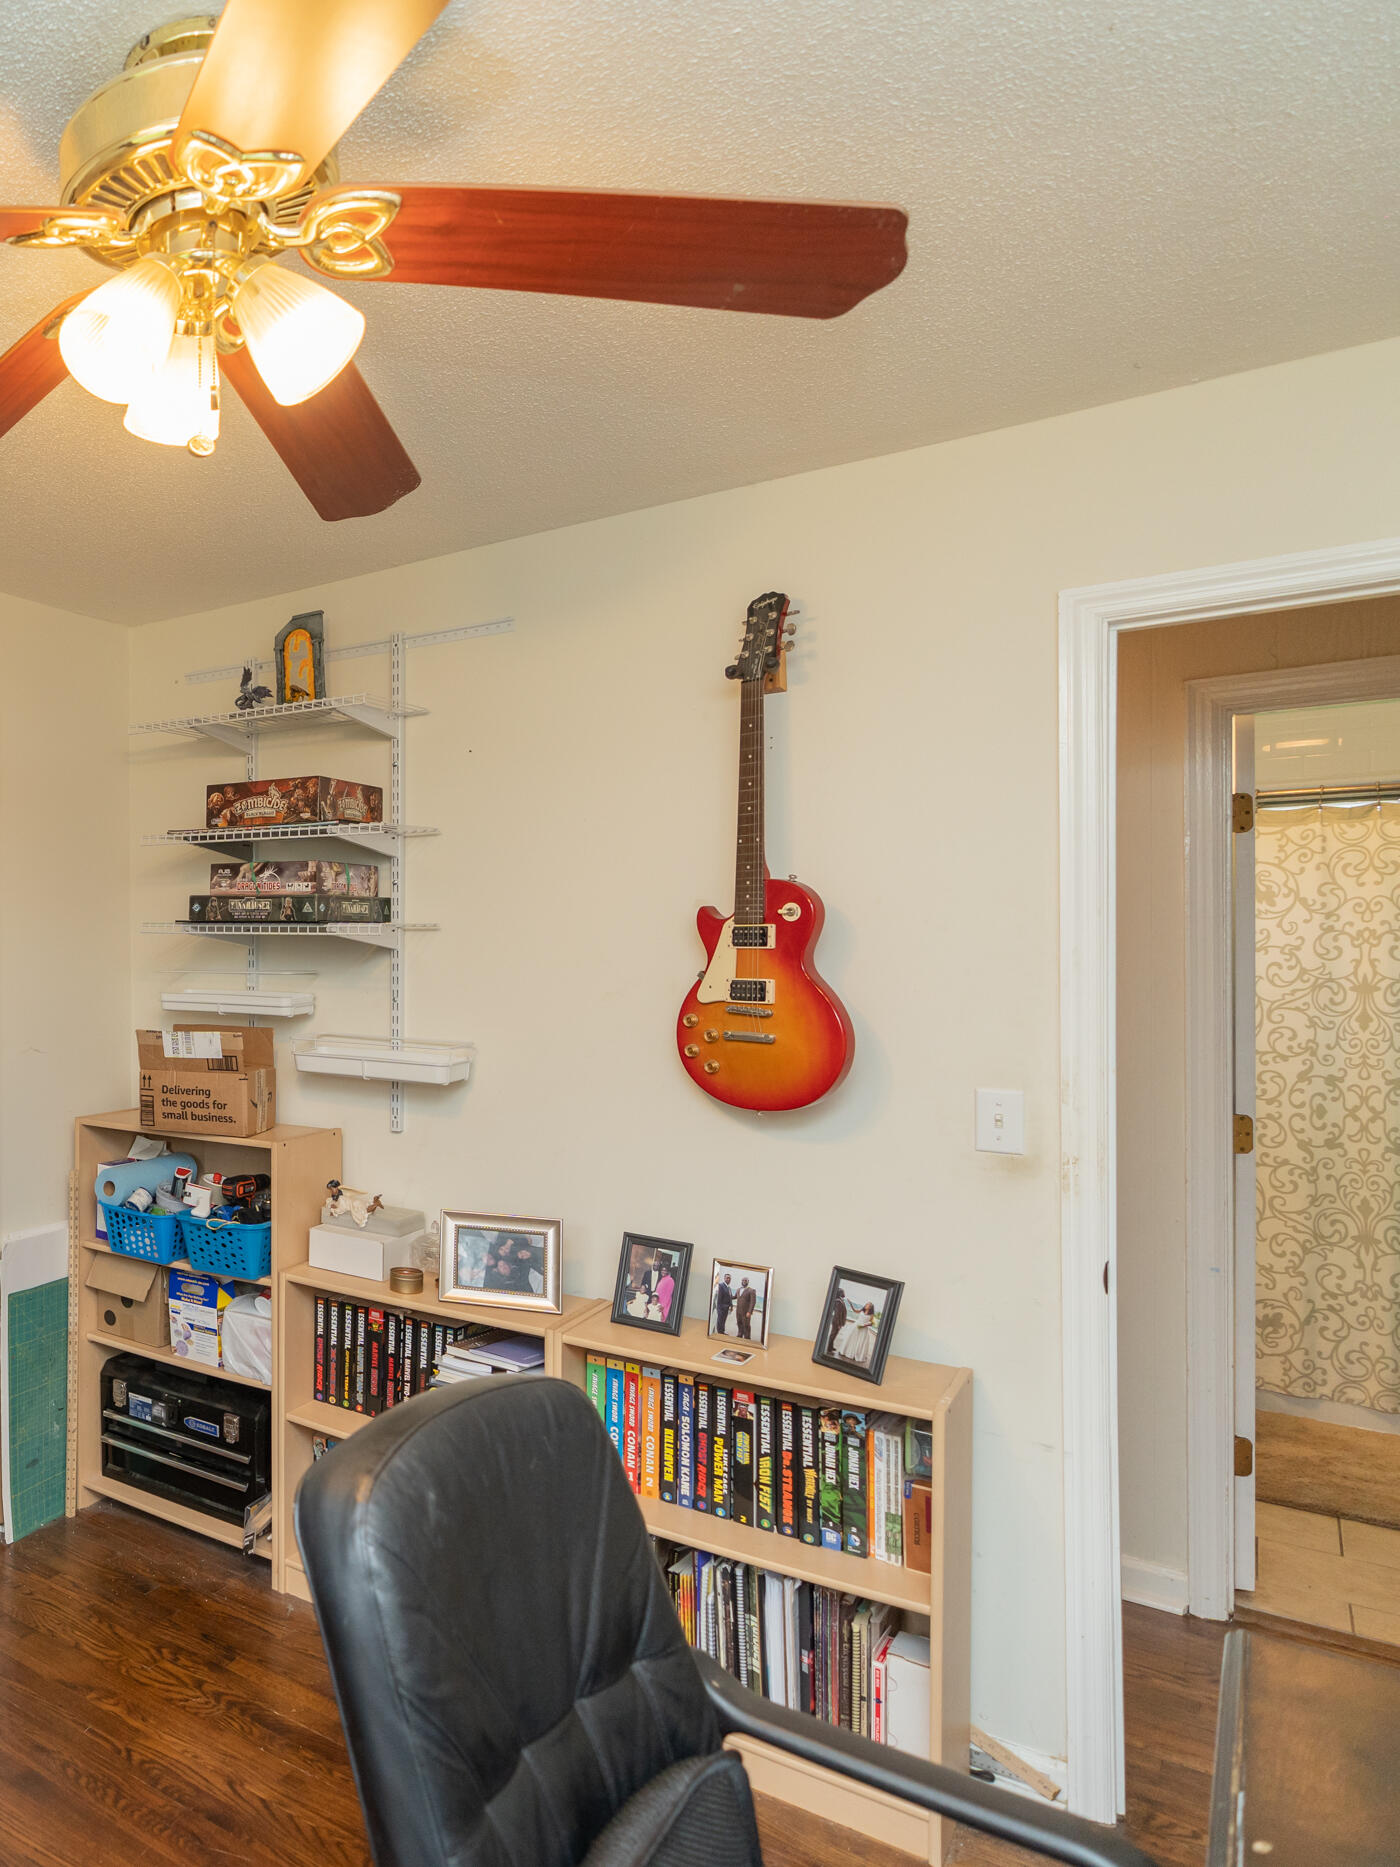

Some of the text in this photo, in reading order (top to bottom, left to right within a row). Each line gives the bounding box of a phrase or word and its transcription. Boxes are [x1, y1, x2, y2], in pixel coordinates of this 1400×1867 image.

[262, 881, 281, 890] TIDES
[161, 1085, 211, 1098] Delivering
[161, 1098, 227, 1109] the goods for
[161, 1111, 236, 1123] small business.
[664, 1383, 673, 1422] ESSENTIAL
[717, 1396, 726, 1435] ESSENTIAL
[627, 1430, 636, 1468] CONAN
[681, 1416, 689, 1466] SOLOMON
[697, 1390, 707, 1497] ESSENTIAL GHOST RIDER
[782, 1410, 792, 1451] ESSENTIAL
[802, 1416, 812, 1467] ESSENTIAL
[645, 1435, 655, 1473] CONAN
[714, 1437, 723, 1503] POWER MAN
[759, 1404, 772, 1514] ESSENTIAL IRON FIST
[825, 1442, 835, 1485] JONAH HEX
[848, 1447, 860, 1491] JONAH HEX
[646, 1477, 653, 1487] 2
[681, 1467, 689, 1496] KANE
[783, 1469, 793, 1525] STRANGE
[804, 1468, 817, 1499] WEREWOLF
[806, 1499, 812, 1507] BY
